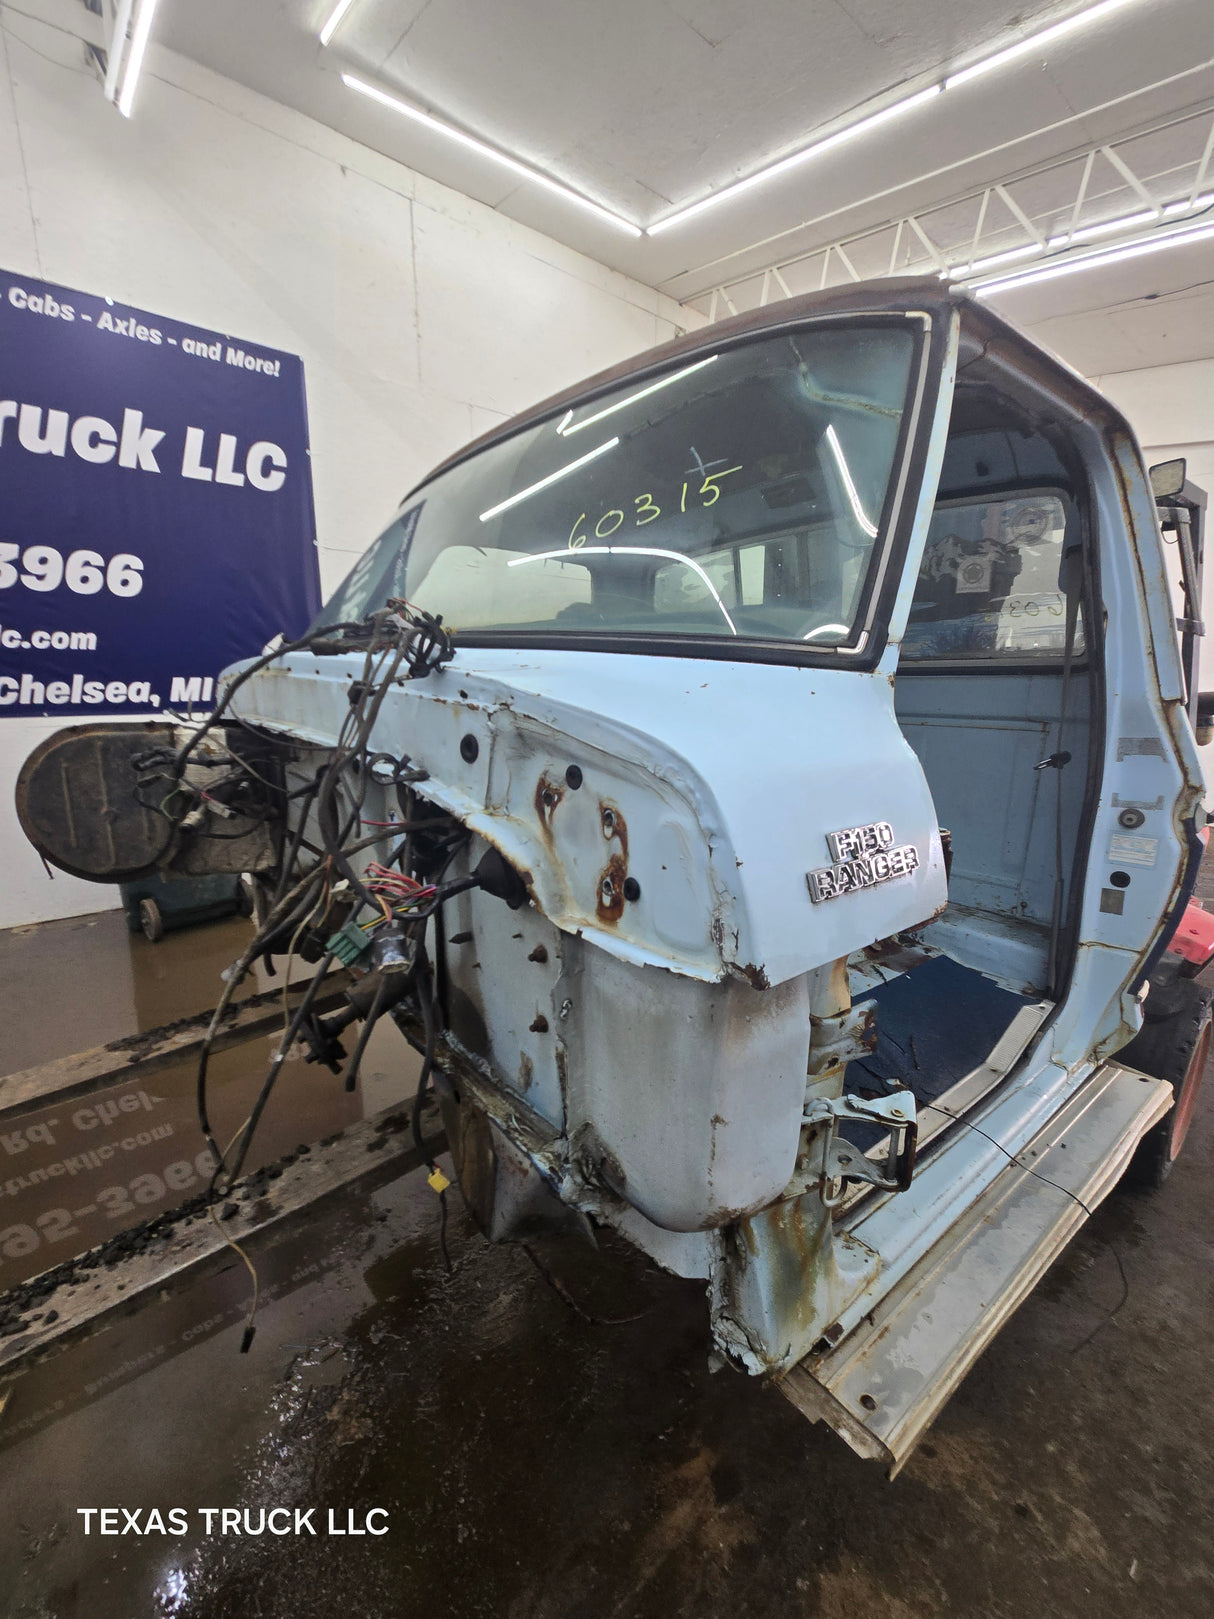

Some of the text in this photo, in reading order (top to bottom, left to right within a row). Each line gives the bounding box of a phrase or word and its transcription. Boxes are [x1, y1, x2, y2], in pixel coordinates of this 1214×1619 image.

[8, 286, 75, 322] Cabs
[97, 311, 162, 345] Axles
[182, 337, 222, 362] and
[225, 346, 280, 377] More!
[181, 426, 287, 491] LLC
[569, 465, 743, 549] 60315
[0, 624, 97, 650] c.com
[0, 673, 213, 707] Chelsea, MI
[806, 845, 920, 904] RANGER
